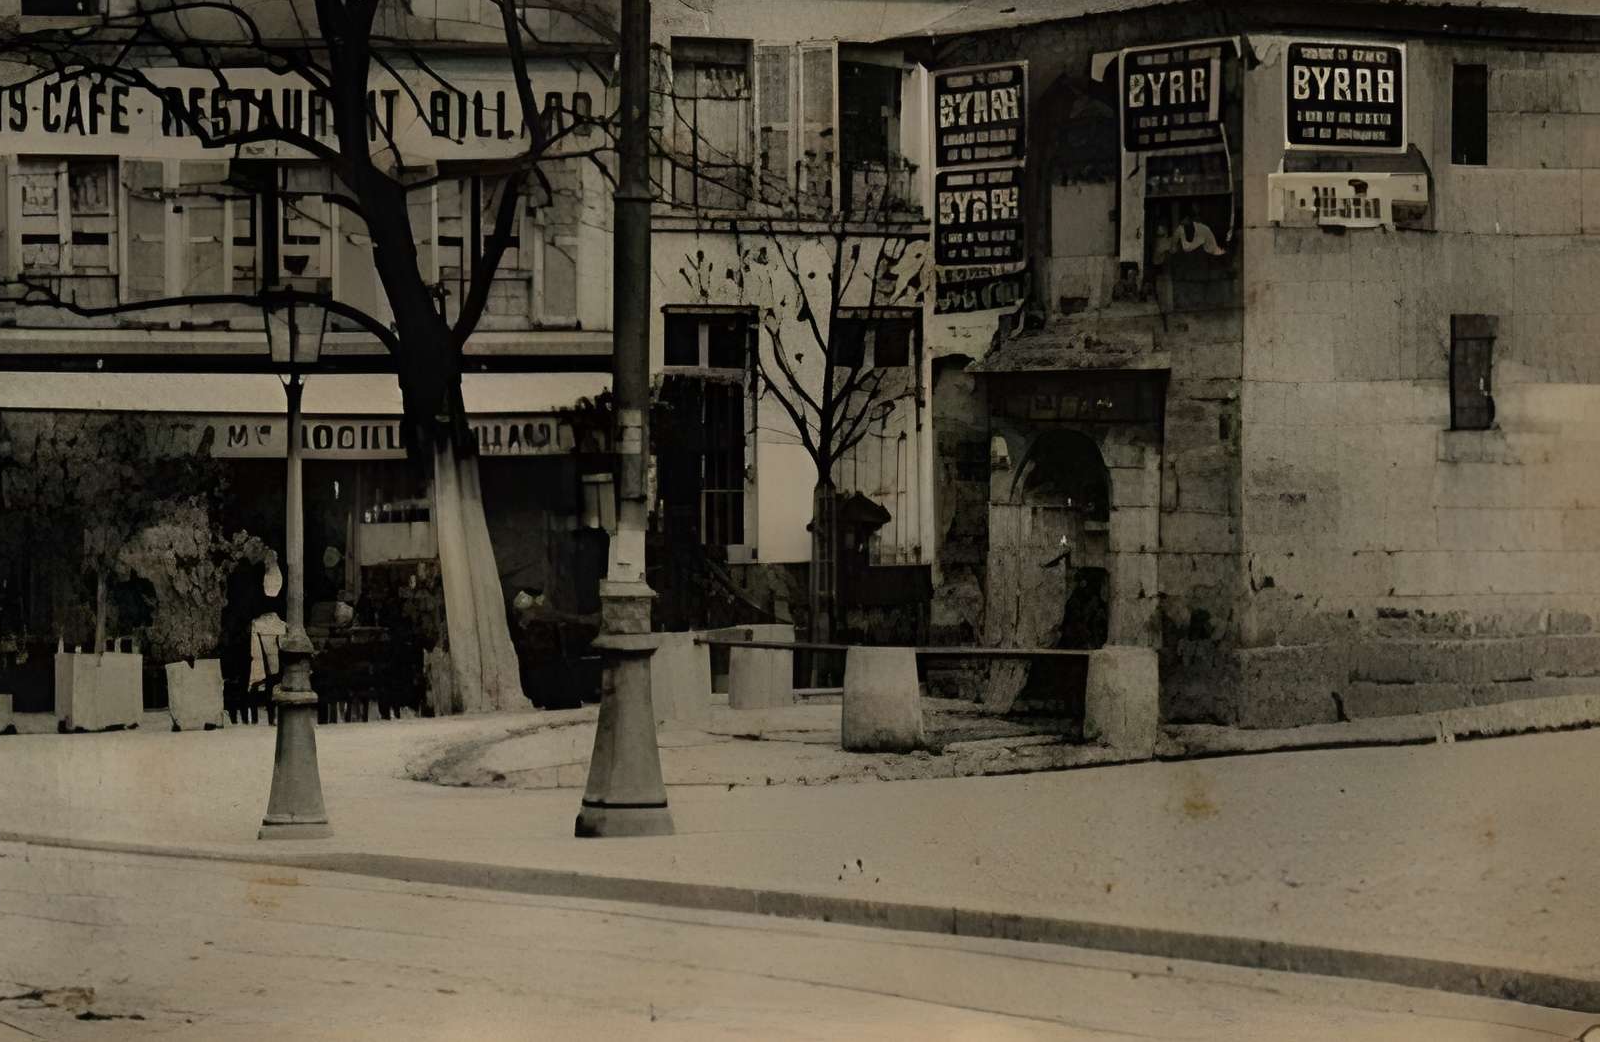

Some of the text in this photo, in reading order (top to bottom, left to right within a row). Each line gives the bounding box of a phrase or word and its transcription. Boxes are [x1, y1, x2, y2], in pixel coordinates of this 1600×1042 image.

[1292, 64, 1396, 105] BYRRH
[160, 85, 400, 143] RESTAURT
[429, 89, 593, 144] BILLRD
